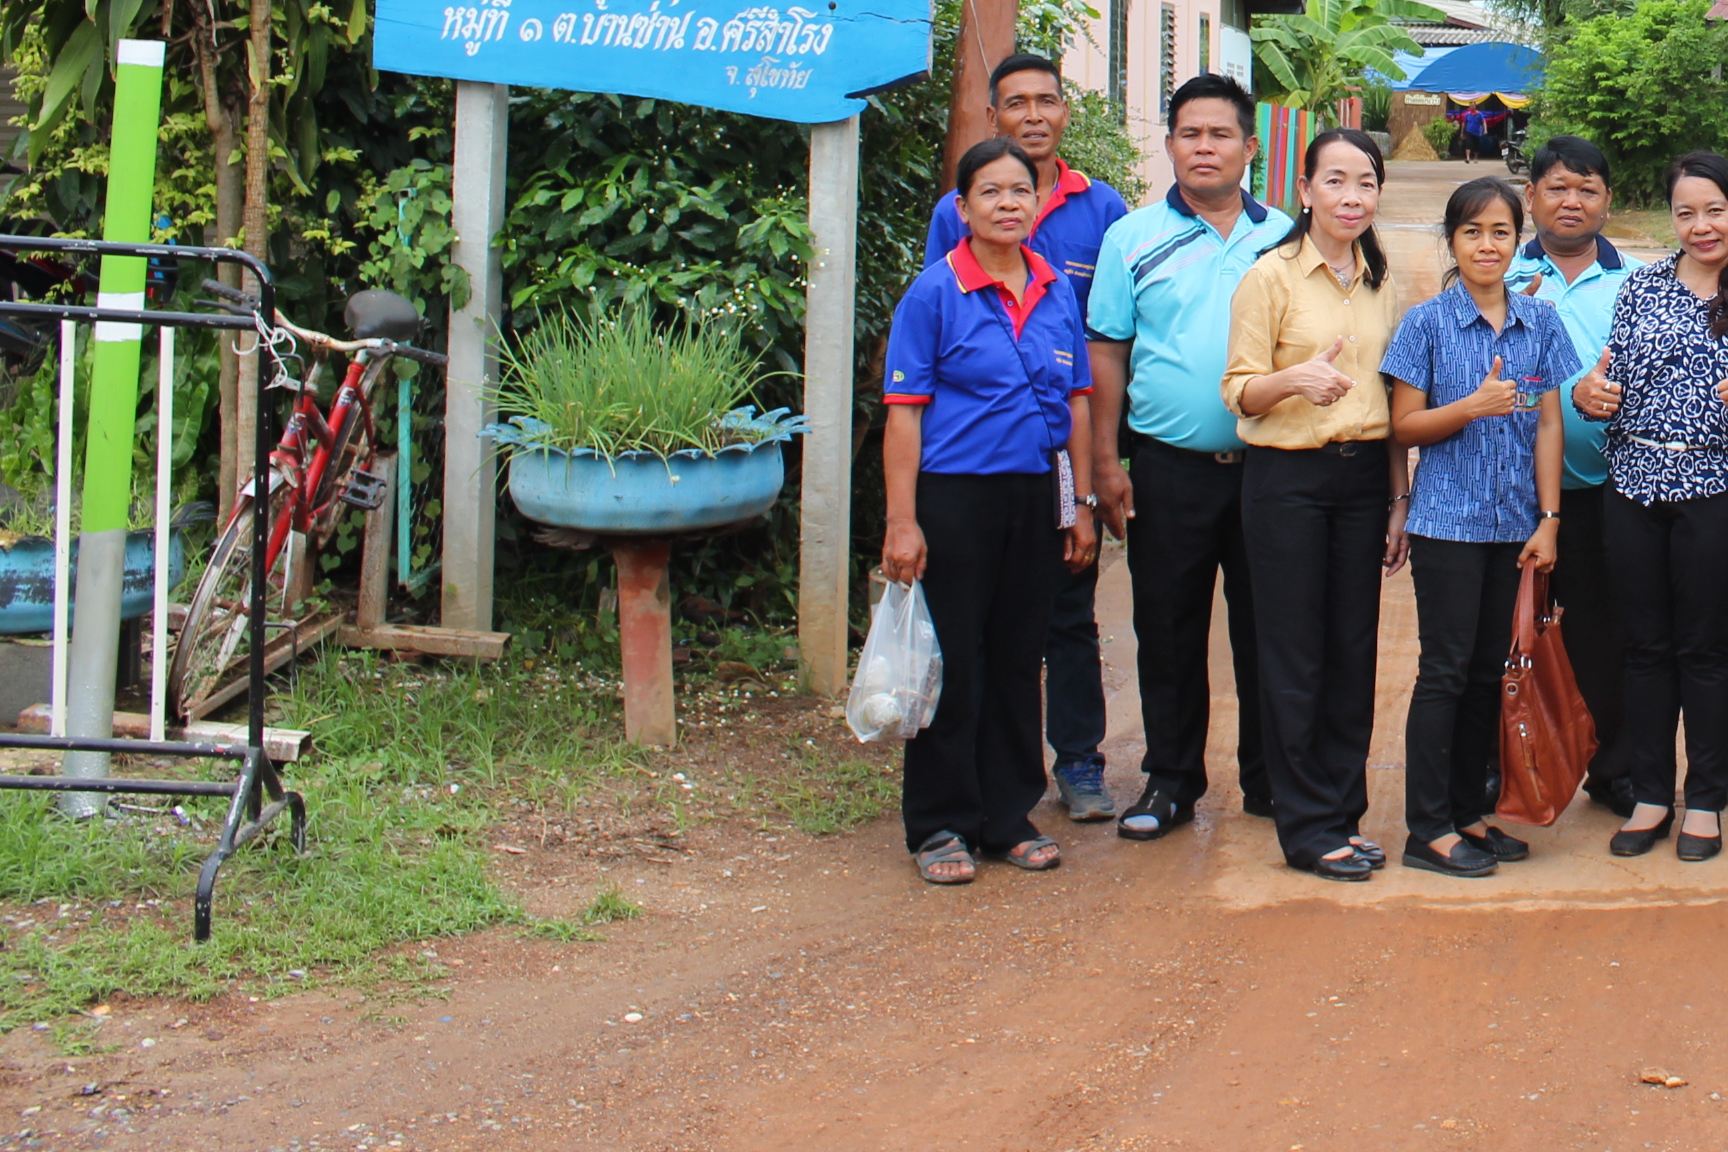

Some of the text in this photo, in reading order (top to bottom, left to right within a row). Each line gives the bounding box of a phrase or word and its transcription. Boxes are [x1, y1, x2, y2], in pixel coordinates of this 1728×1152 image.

[519, 18, 543, 43] ๑
[744, 56, 814, 99] สุโขทัย
